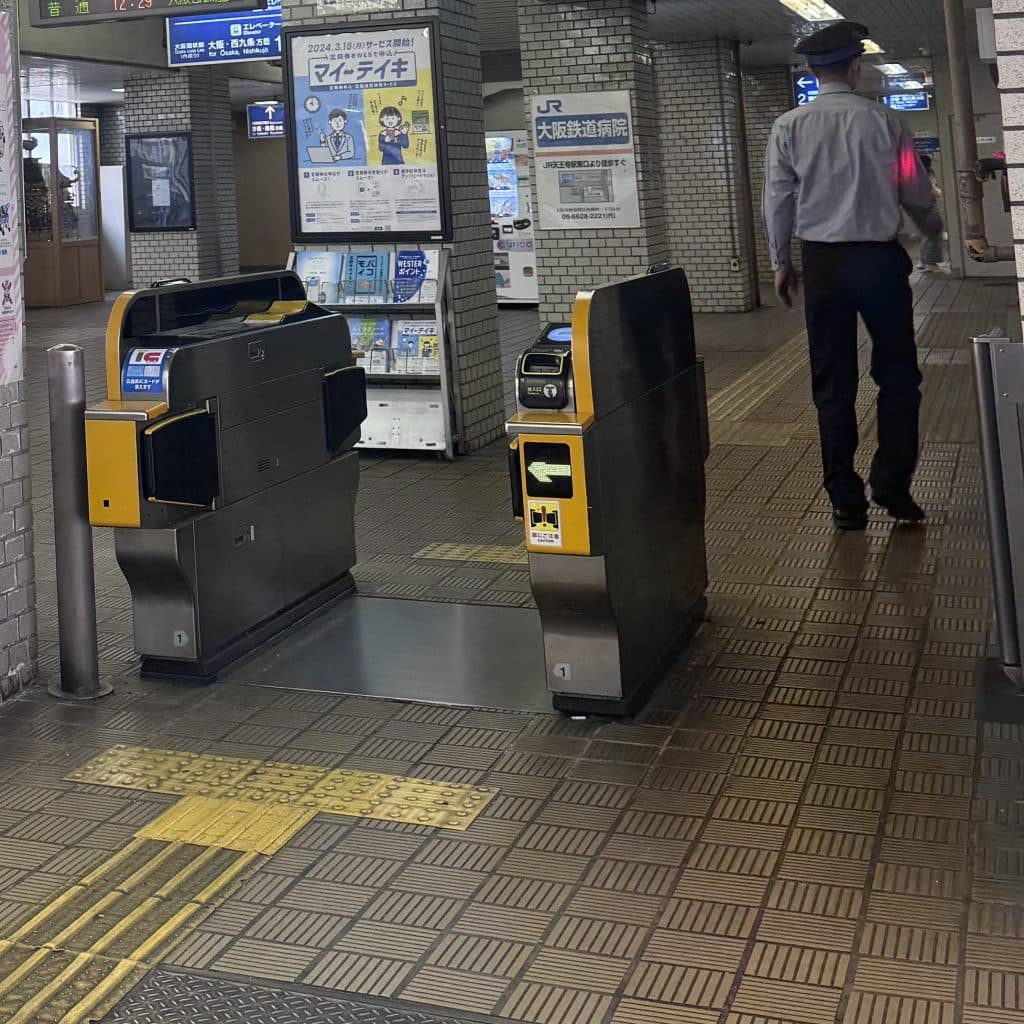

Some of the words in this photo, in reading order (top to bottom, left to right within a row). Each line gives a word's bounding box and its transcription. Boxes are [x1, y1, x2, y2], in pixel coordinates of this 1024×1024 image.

[537, 99, 562, 113] JR
[797, 93, 807, 106] 2
[537, 118, 629, 140] 大阪鉄道病院
[397, 259, 422, 268] WESTER
[135, 352, 162, 362] IC
